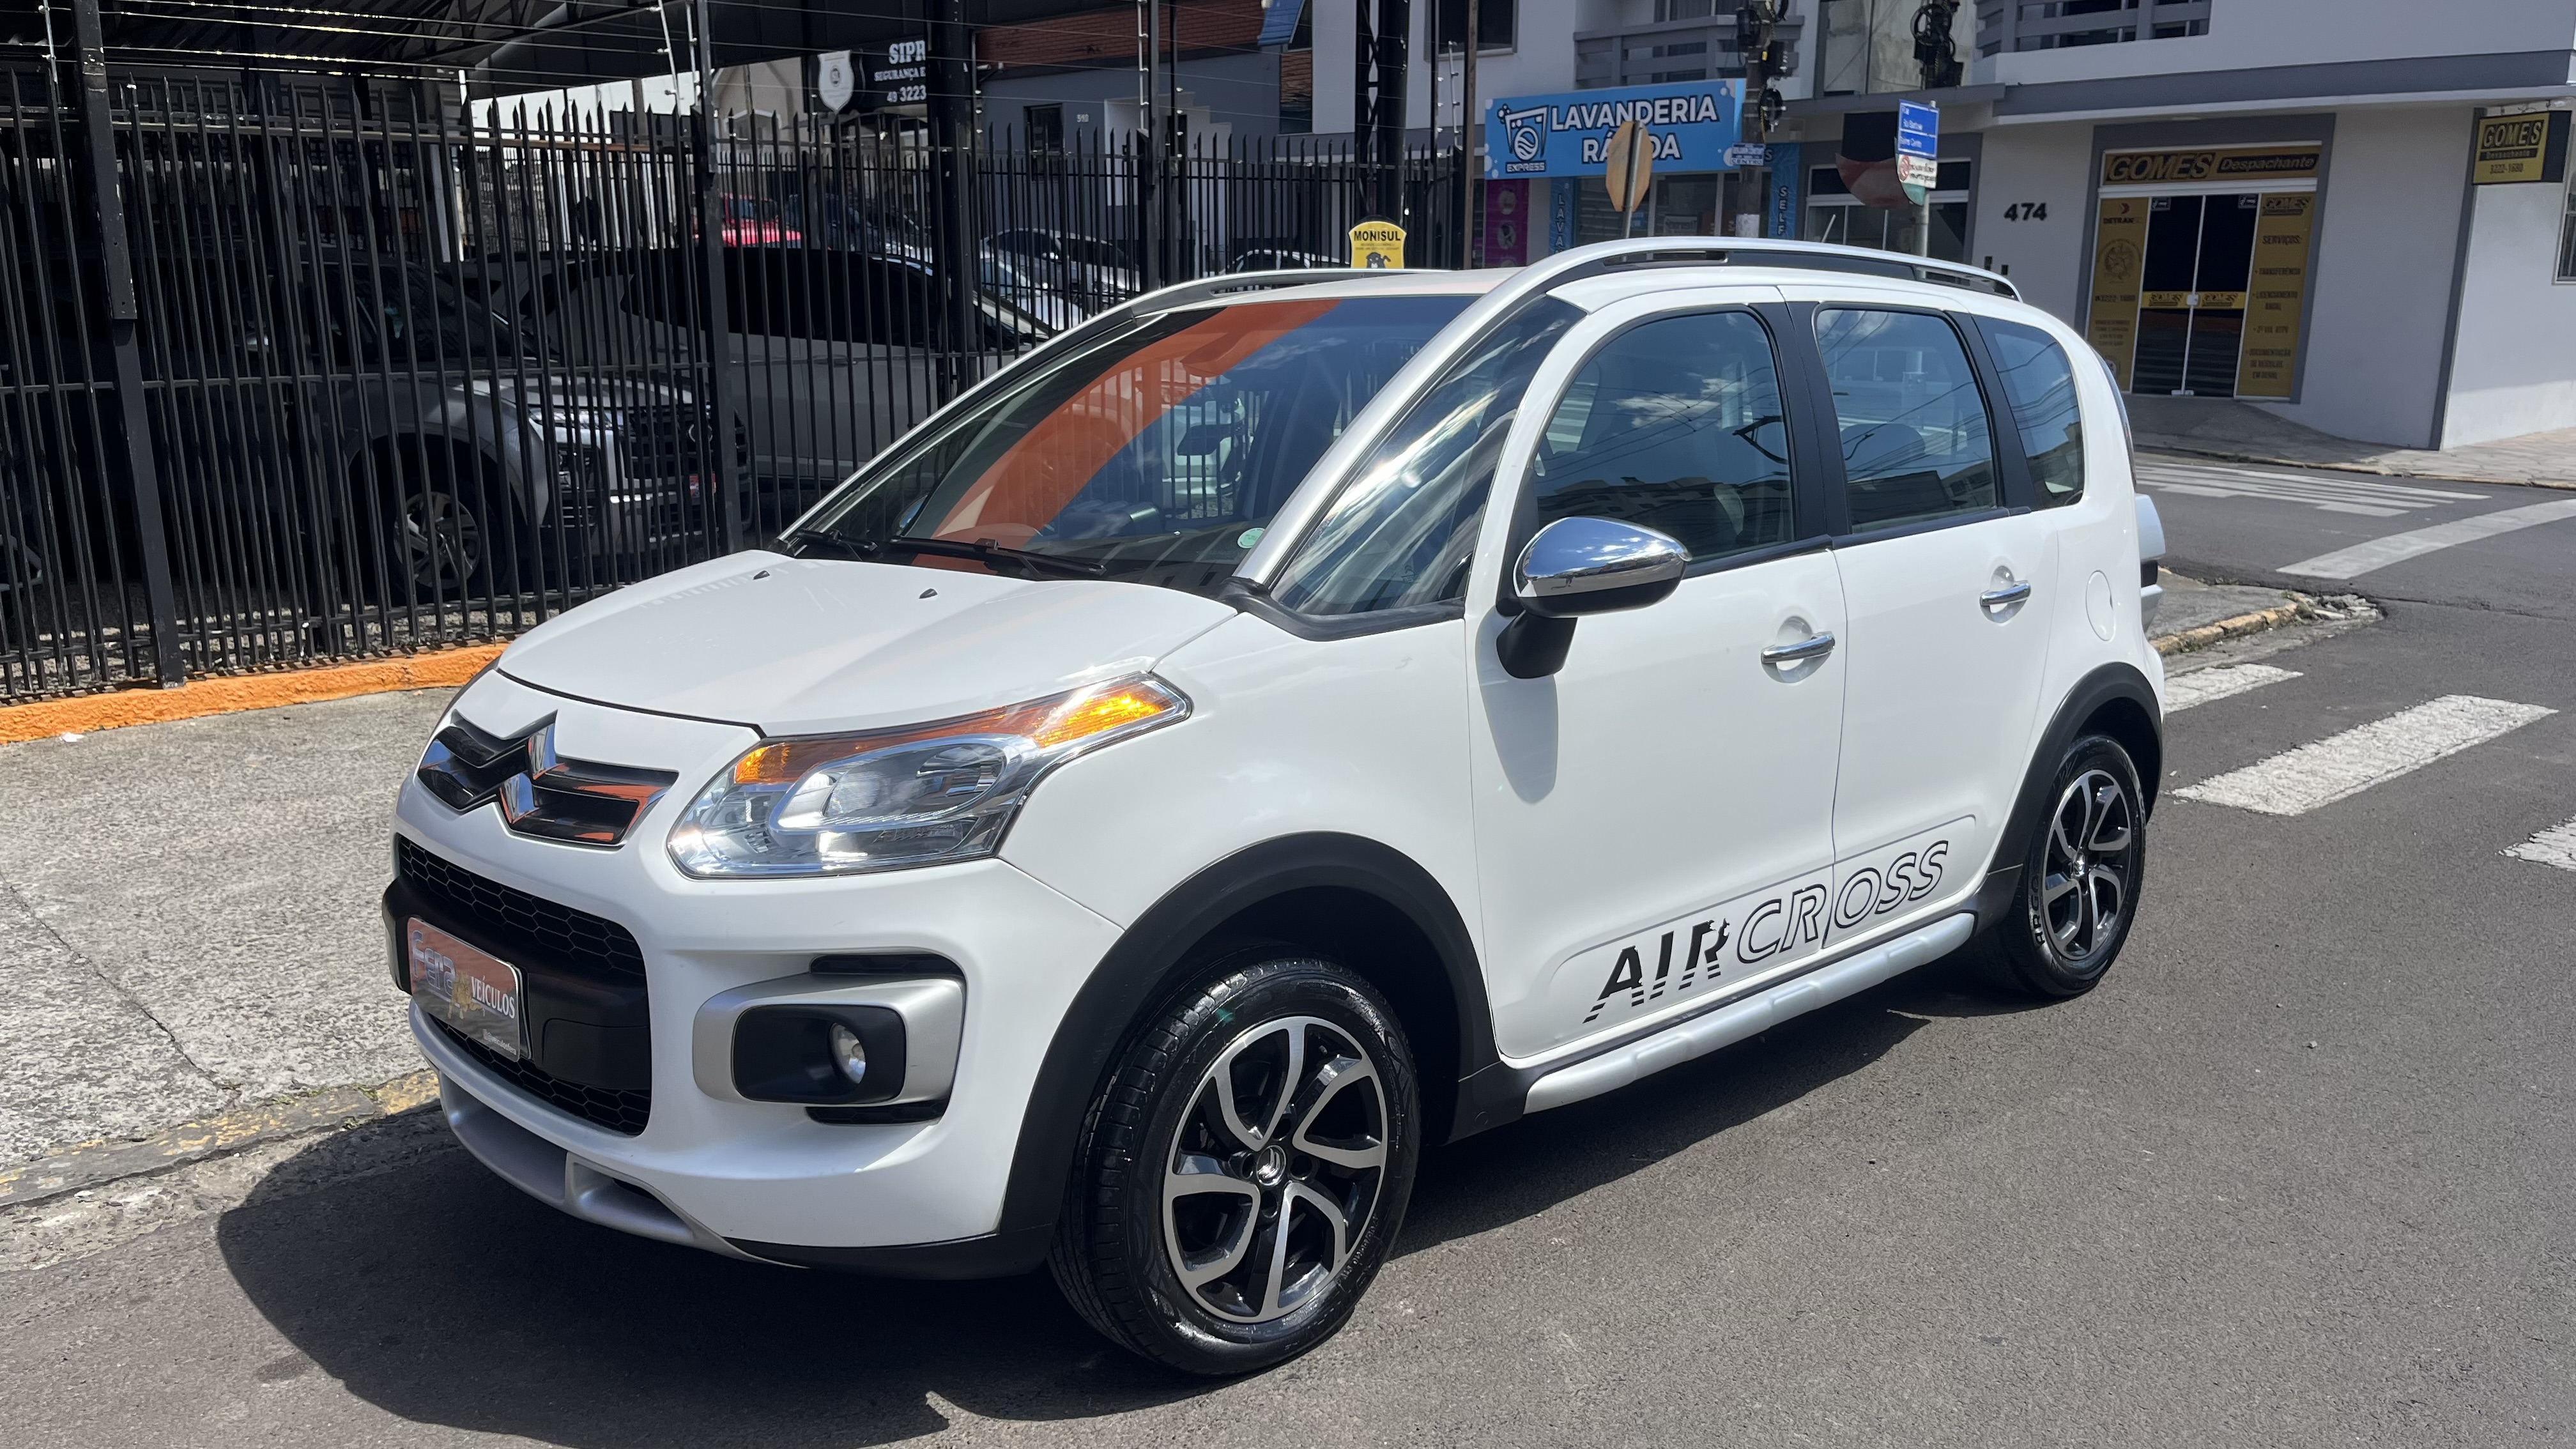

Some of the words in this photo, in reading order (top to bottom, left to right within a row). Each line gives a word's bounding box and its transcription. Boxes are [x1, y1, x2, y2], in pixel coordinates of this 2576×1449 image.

[1551, 95, 1719, 130] LAVANDERIA
[1582, 130, 1682, 163] RÁDA
[2483, 122, 2542, 148] GOMES
[1506, 162, 1545, 172] EXPRESS
[2108, 153, 2216, 181] GOMES
[2004, 203, 2047, 221] 474
[1354, 231, 1400, 241] MONISUL
[1583, 840, 1949, 1024] AIRCROSS
[471, 976, 515, 1019] VEÍCULOS
